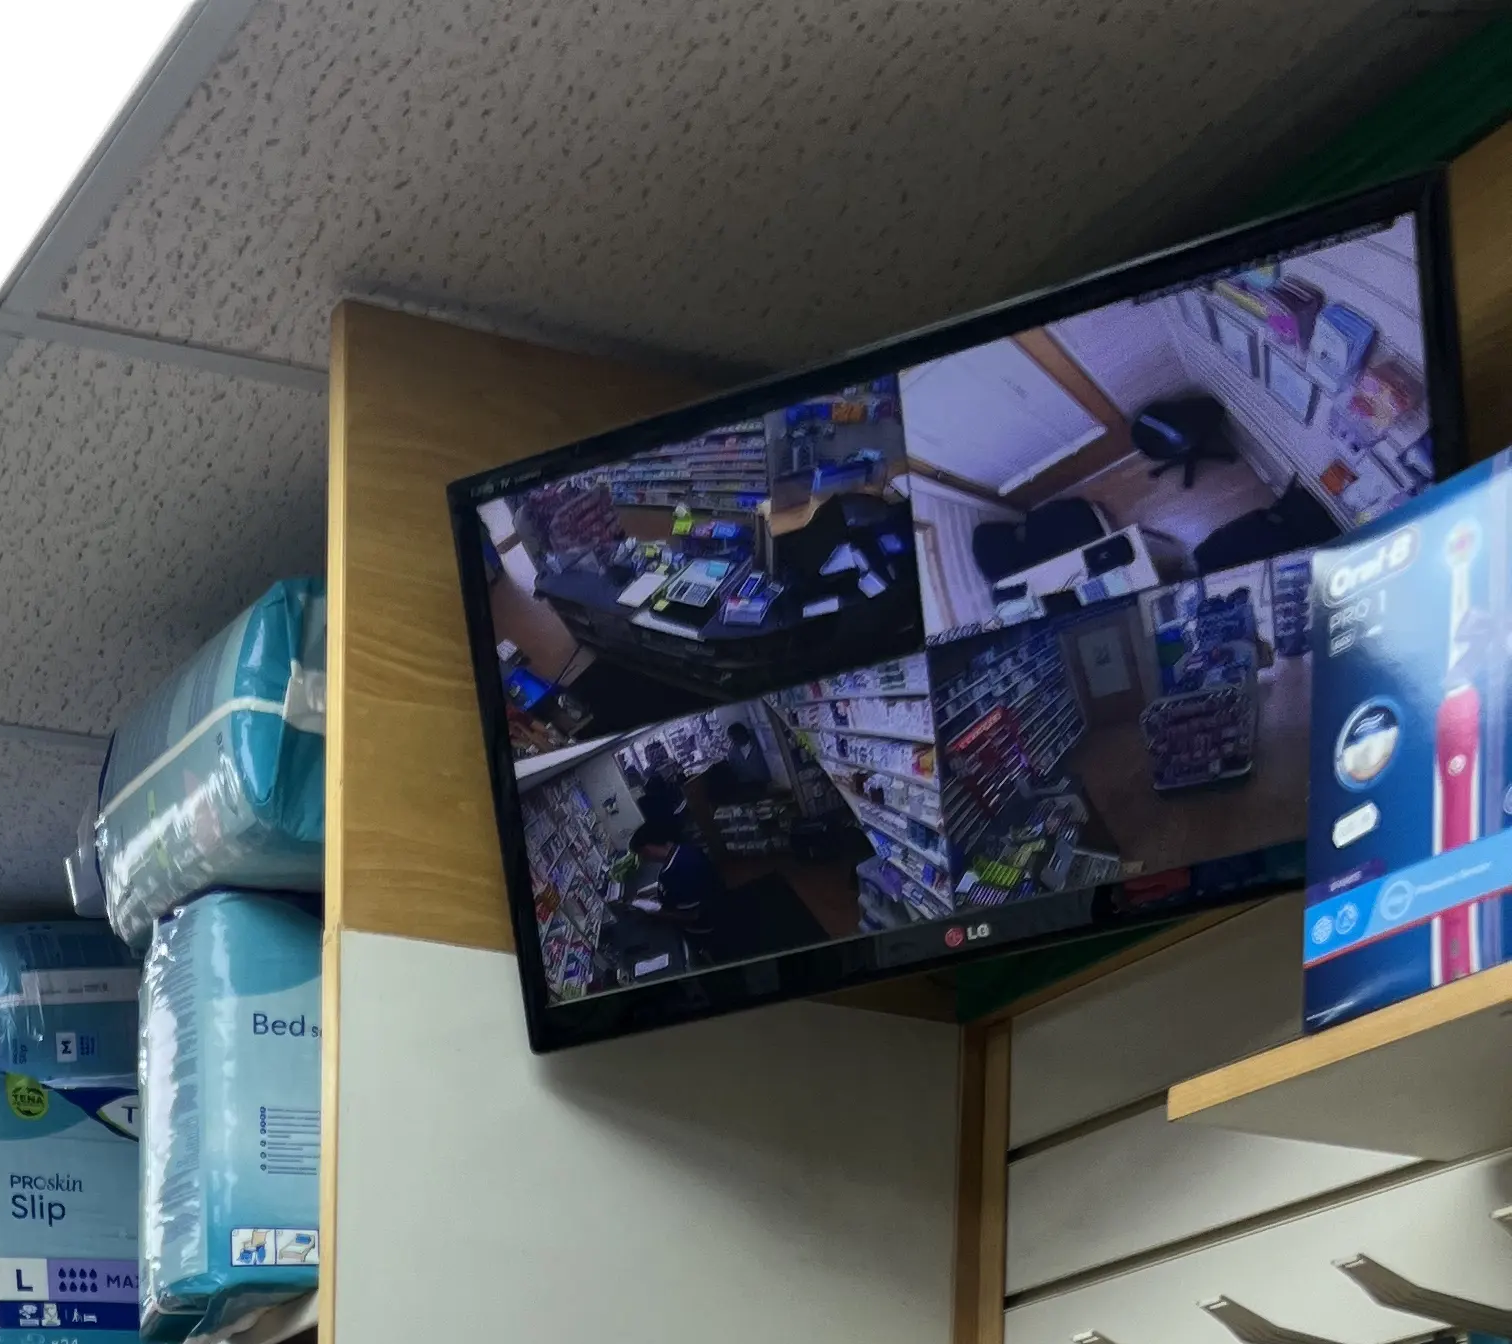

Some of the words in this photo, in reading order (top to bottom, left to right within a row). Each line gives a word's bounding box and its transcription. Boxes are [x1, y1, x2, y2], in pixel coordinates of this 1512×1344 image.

[1329, 532, 1413, 599] Oral-B
[1329, 603, 1371, 632] PRO
[967, 924, 990, 940] LG
[253, 1013, 306, 1037] Bed
[11, 1092, 45, 1106] TENA
[10, 1173, 84, 1194] PROskin
[11, 1195, 67, 1227] Slip
[16, 1268, 34, 1292] L
